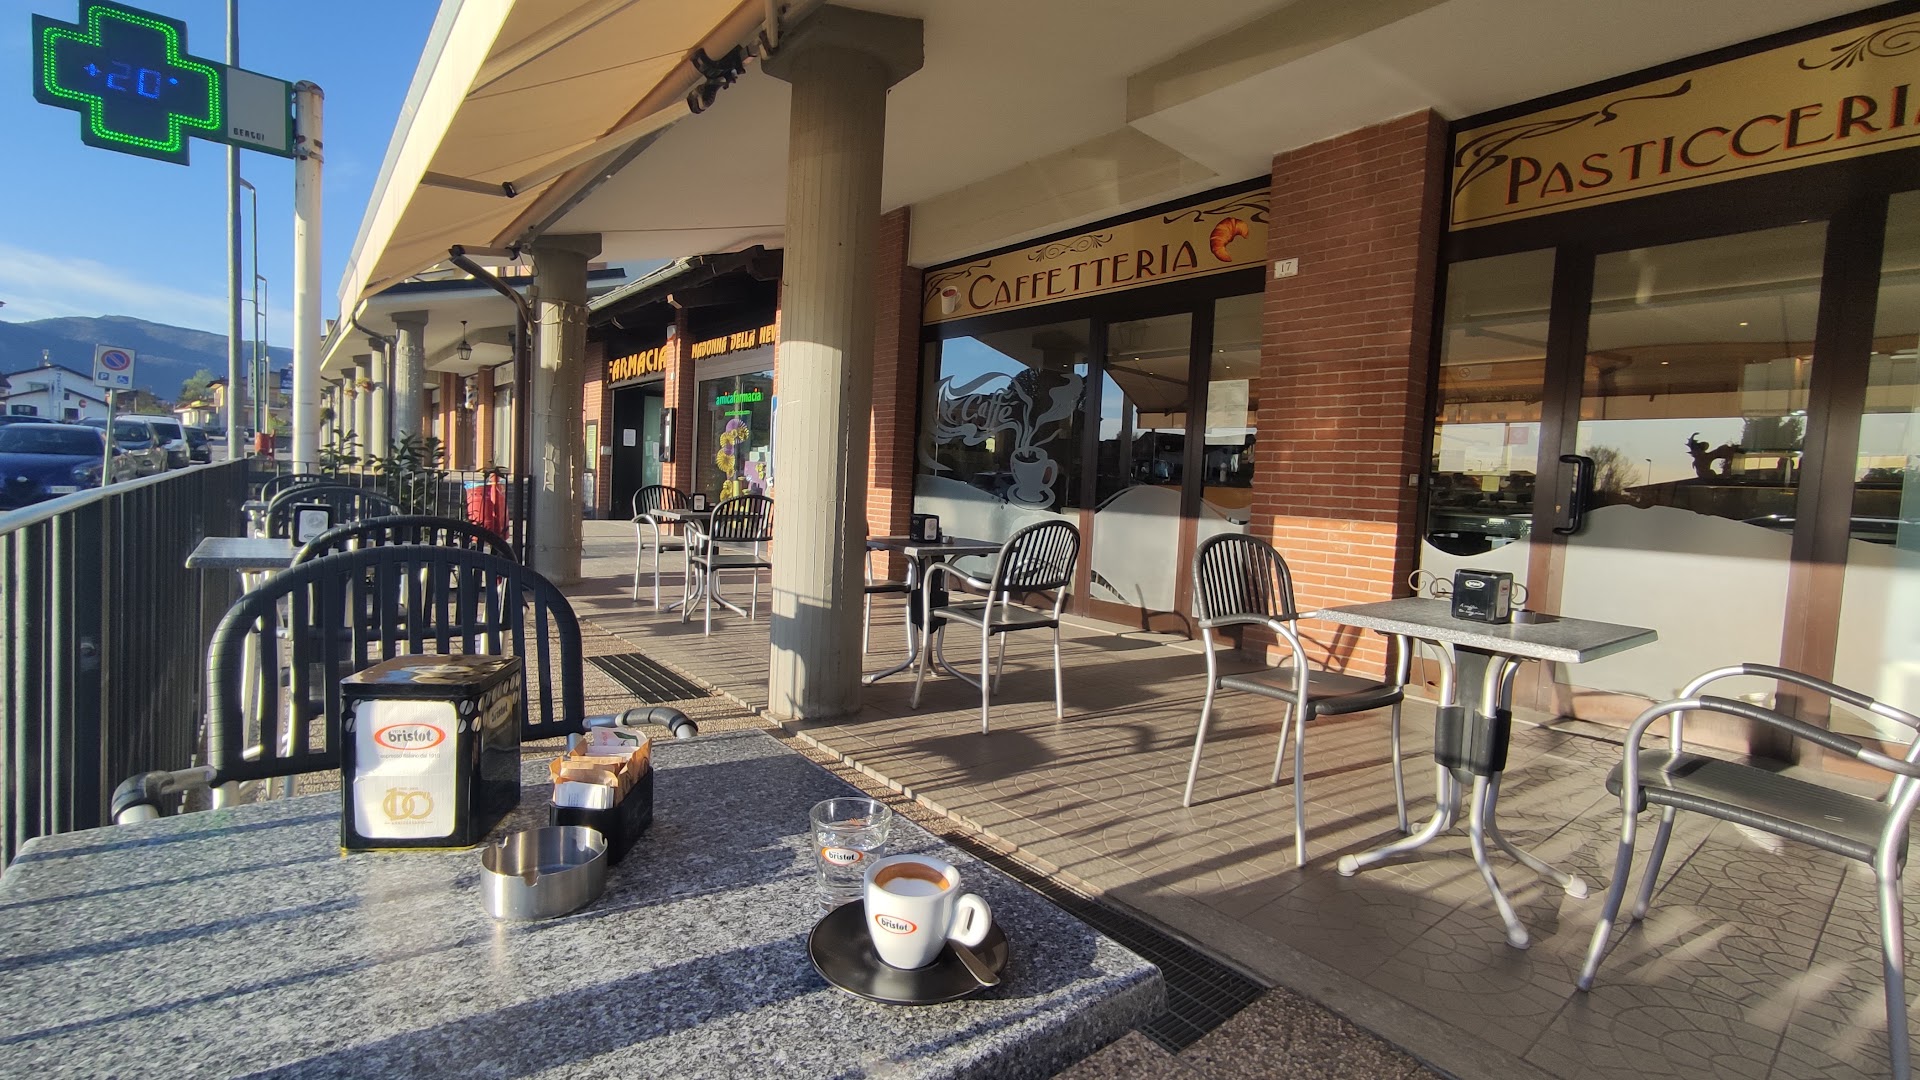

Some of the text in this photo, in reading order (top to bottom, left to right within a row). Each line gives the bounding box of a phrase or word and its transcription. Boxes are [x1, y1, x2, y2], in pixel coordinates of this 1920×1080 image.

[1506, 83, 1920, 205] PASTICCERI
[968, 240, 1198, 310] CAFFETTERIA
[1281, 261, 1292, 273] 17
[691, 335, 727, 359] MADONNA
[730, 329, 756, 351] DELLA
[716, 388, 762, 406] amicafarmacia
[388, 729, 432, 742] bristot
[828, 851, 856, 861] bristot
[880, 917, 909, 932] bristot
